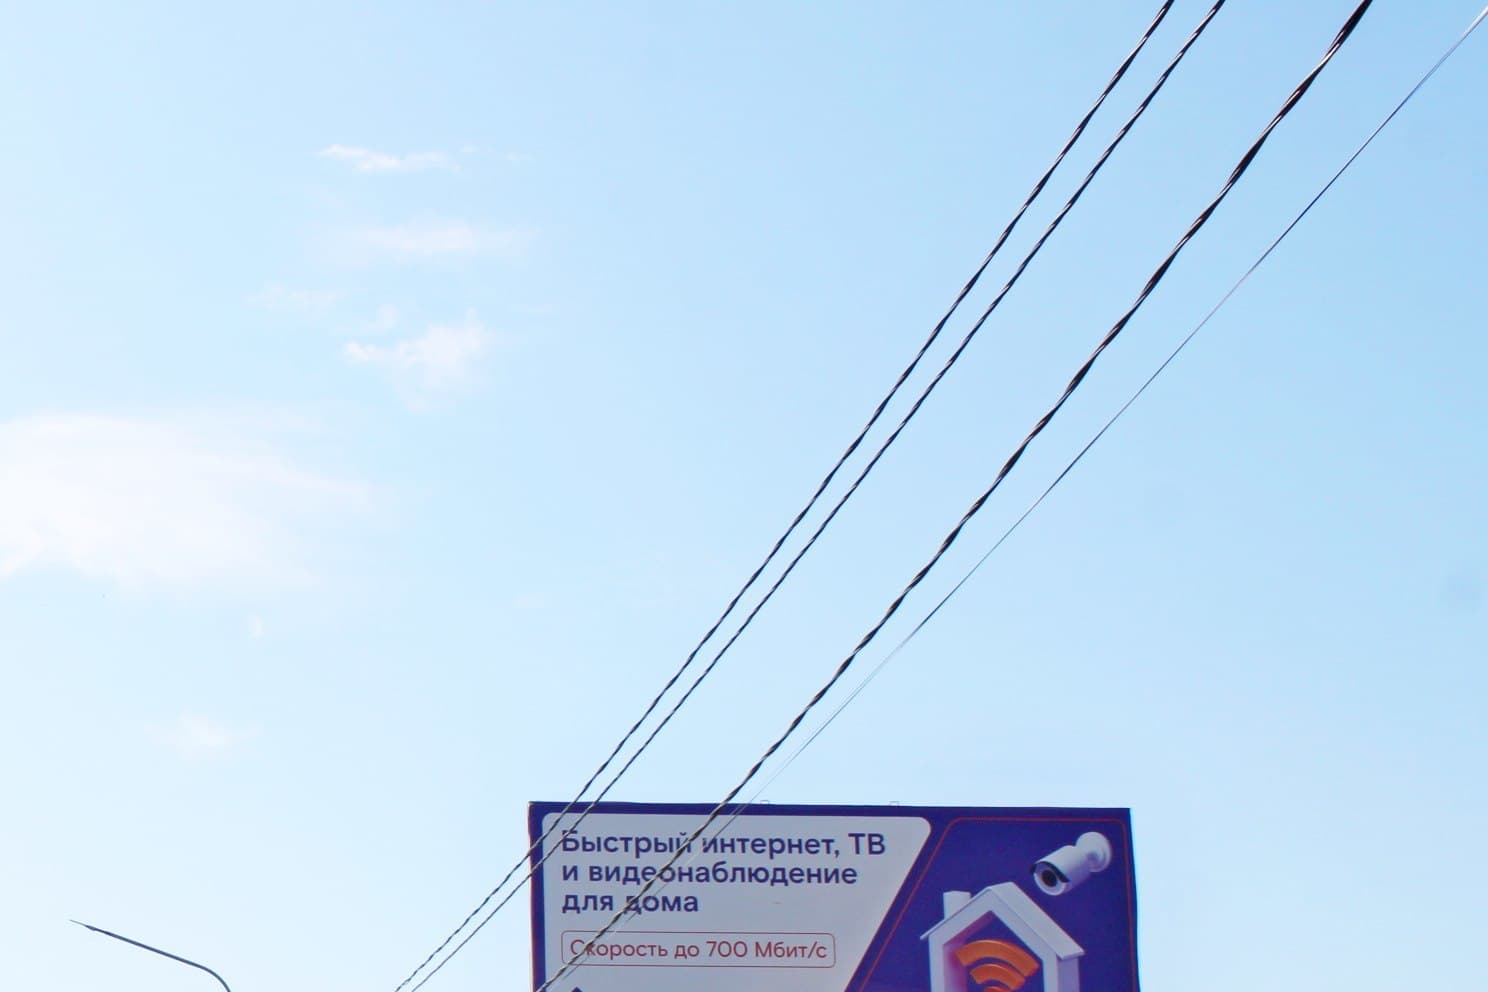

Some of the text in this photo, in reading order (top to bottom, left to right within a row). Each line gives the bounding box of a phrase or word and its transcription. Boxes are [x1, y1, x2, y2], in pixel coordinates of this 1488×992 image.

[562, 830, 886, 860] Быстрый интернет, ТВ
[562, 861, 858, 887] и видеонаблюдение
[562, 894, 614, 914] для
[570, 939, 827, 960] Скорость до 700 Мбит/с
